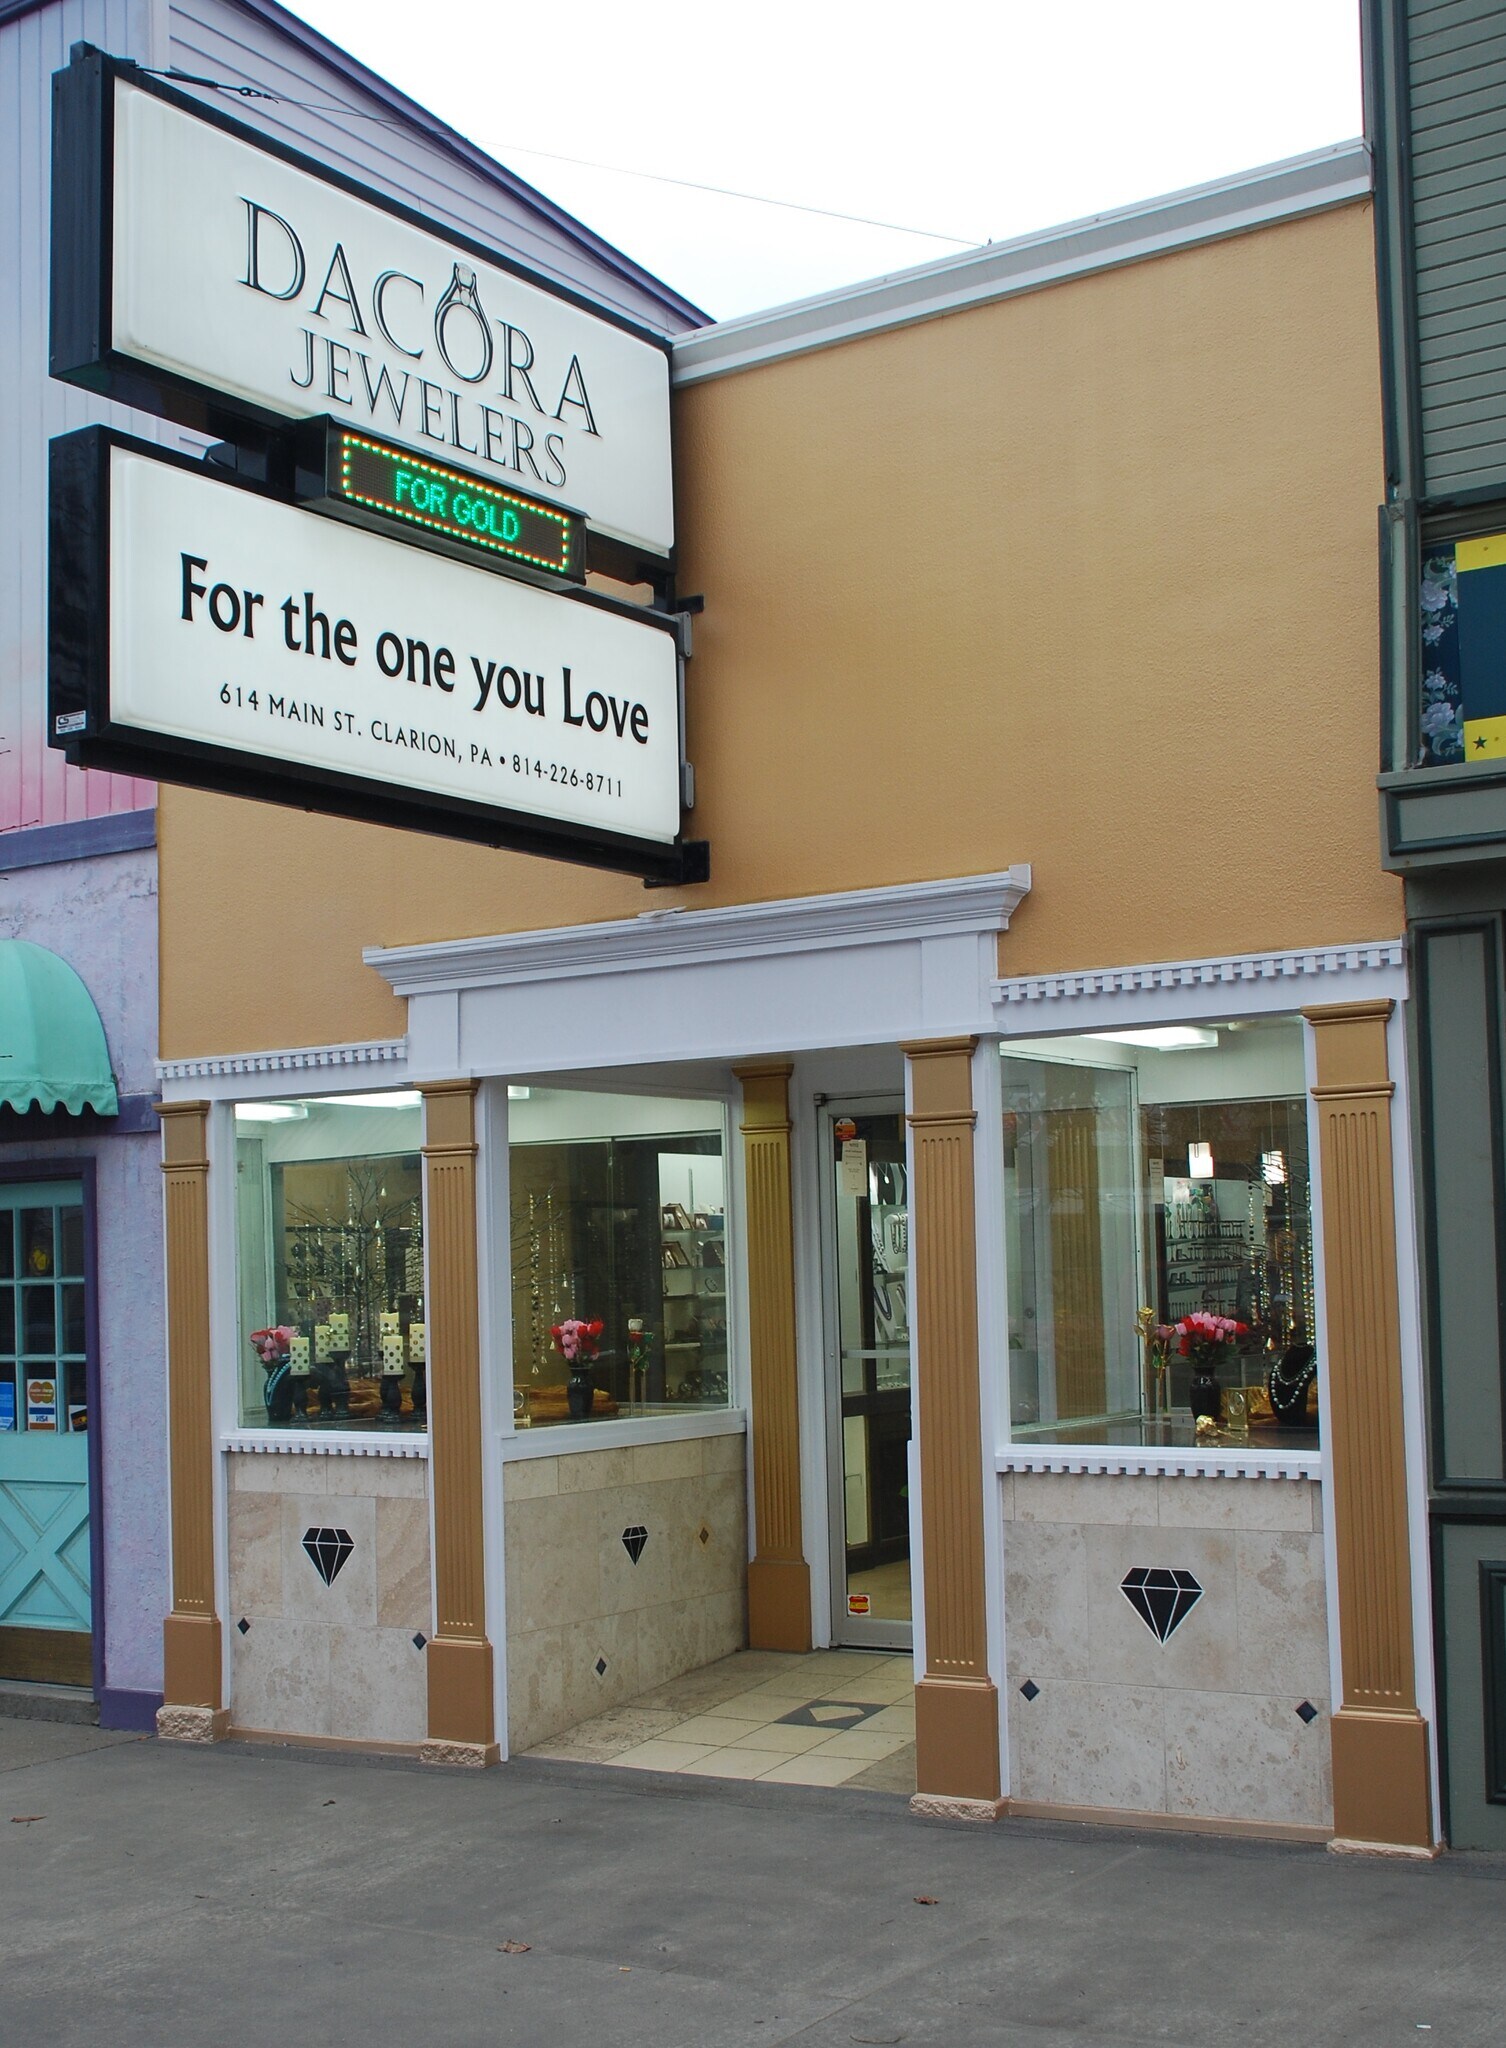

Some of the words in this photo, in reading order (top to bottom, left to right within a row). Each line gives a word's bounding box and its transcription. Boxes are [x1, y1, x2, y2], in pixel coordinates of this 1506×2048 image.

[237, 196, 602, 438] DACORA
[289, 327, 566, 488] JEWELERS
[396, 470, 446, 518] FOR
[452, 493, 519, 541] GOLD
[180, 552, 264, 638] For
[280, 592, 358, 666] the
[376, 631, 455, 692] one
[470, 656, 545, 717] you
[562, 667, 649, 744] Love
[220, 683, 259, 711] 614
[268, 694, 324, 727] MAIN
[334, 711, 362, 736] ST.
[371, 720, 463, 764] CLARION,
[470, 743, 493, 767] PA
[512, 754, 622, 798] 814-226-8711
